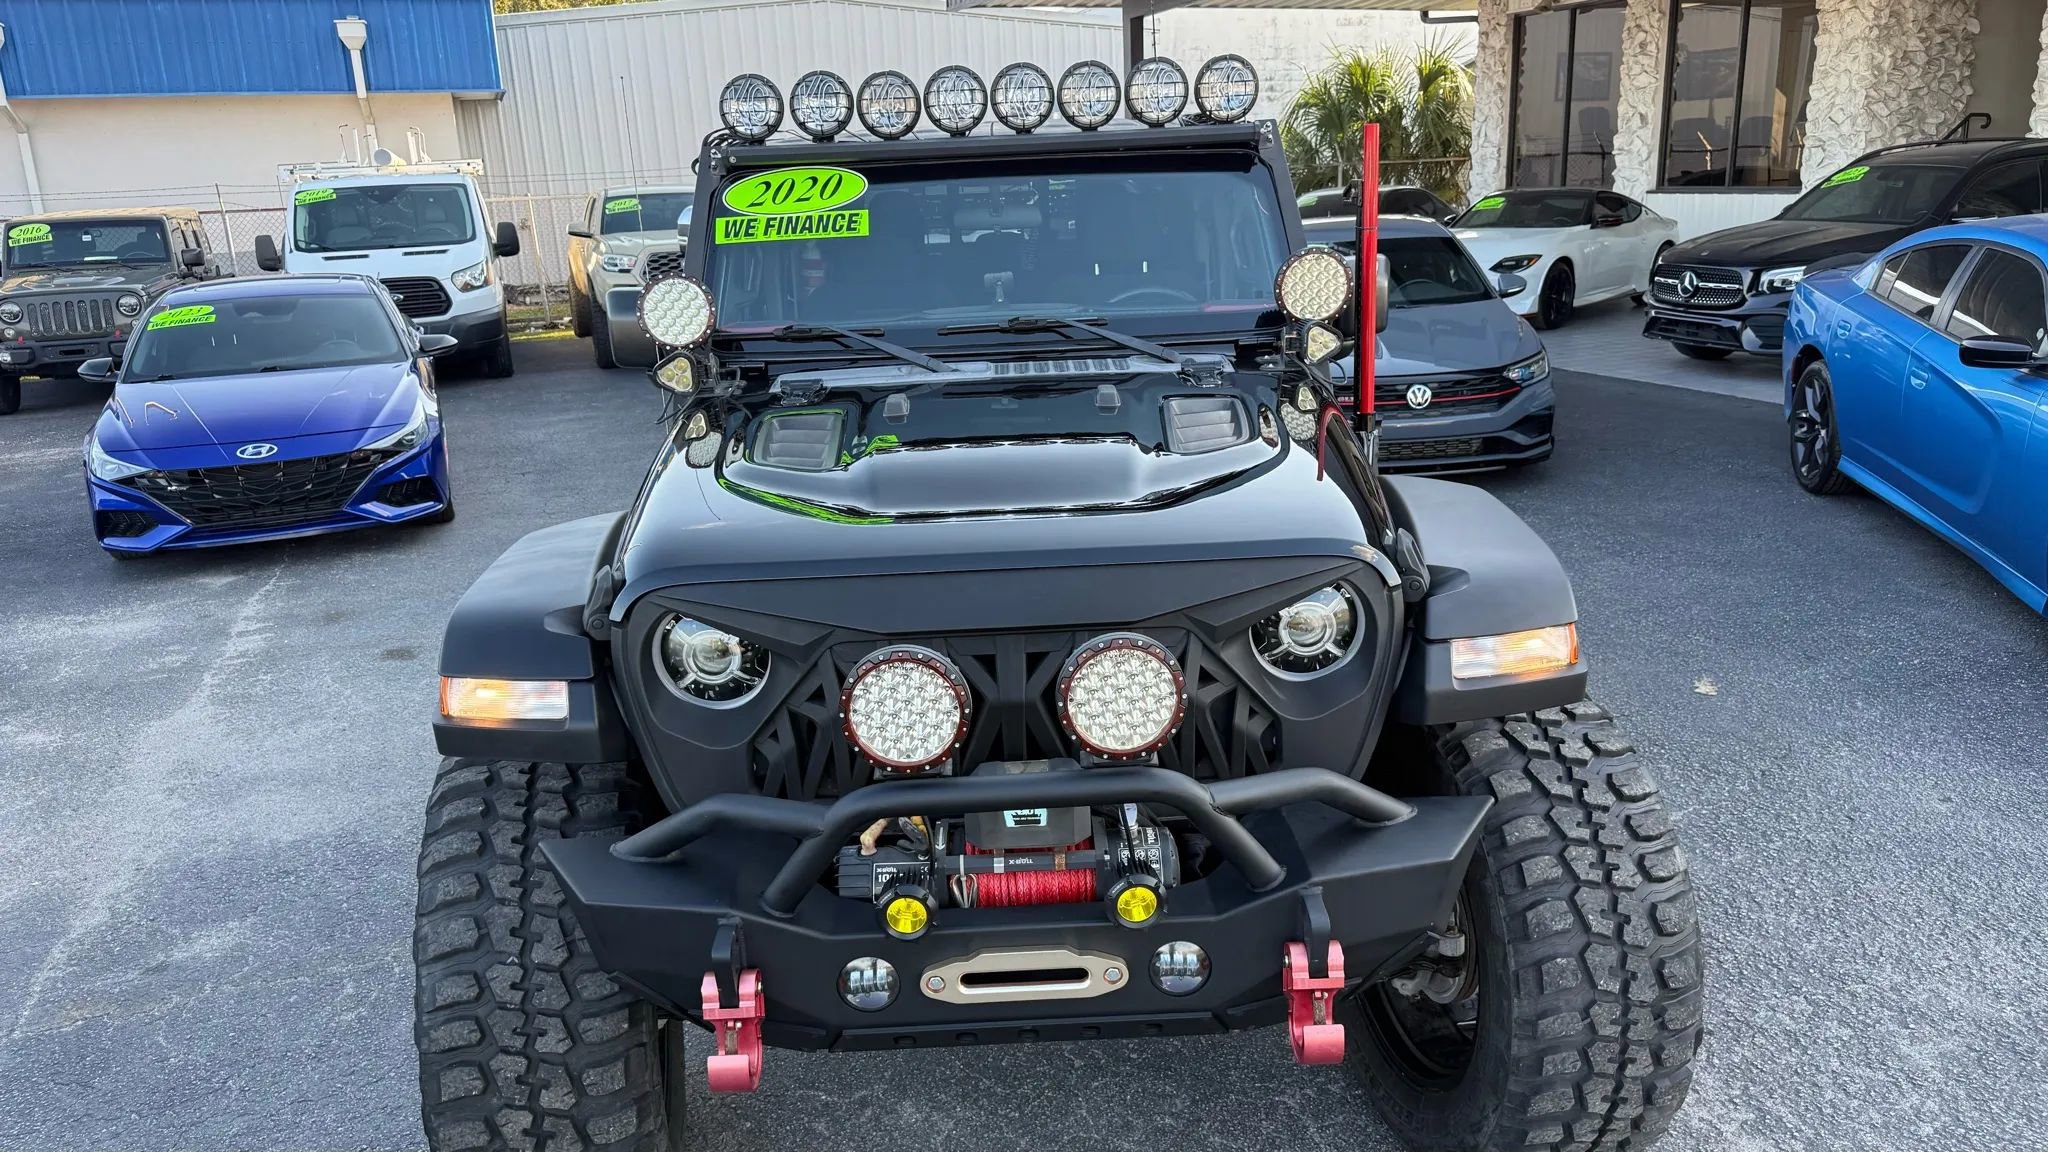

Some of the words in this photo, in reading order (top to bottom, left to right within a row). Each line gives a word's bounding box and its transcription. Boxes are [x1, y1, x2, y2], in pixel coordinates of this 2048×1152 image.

[746, 173, 843, 208] 2020
[16, 226, 42, 237] 2016
[724, 217, 759, 240] WE
[763, 212, 862, 237] FINANCE
[23, 234, 50, 244] FINANCE
[168, 316, 210, 326] FINANCE
